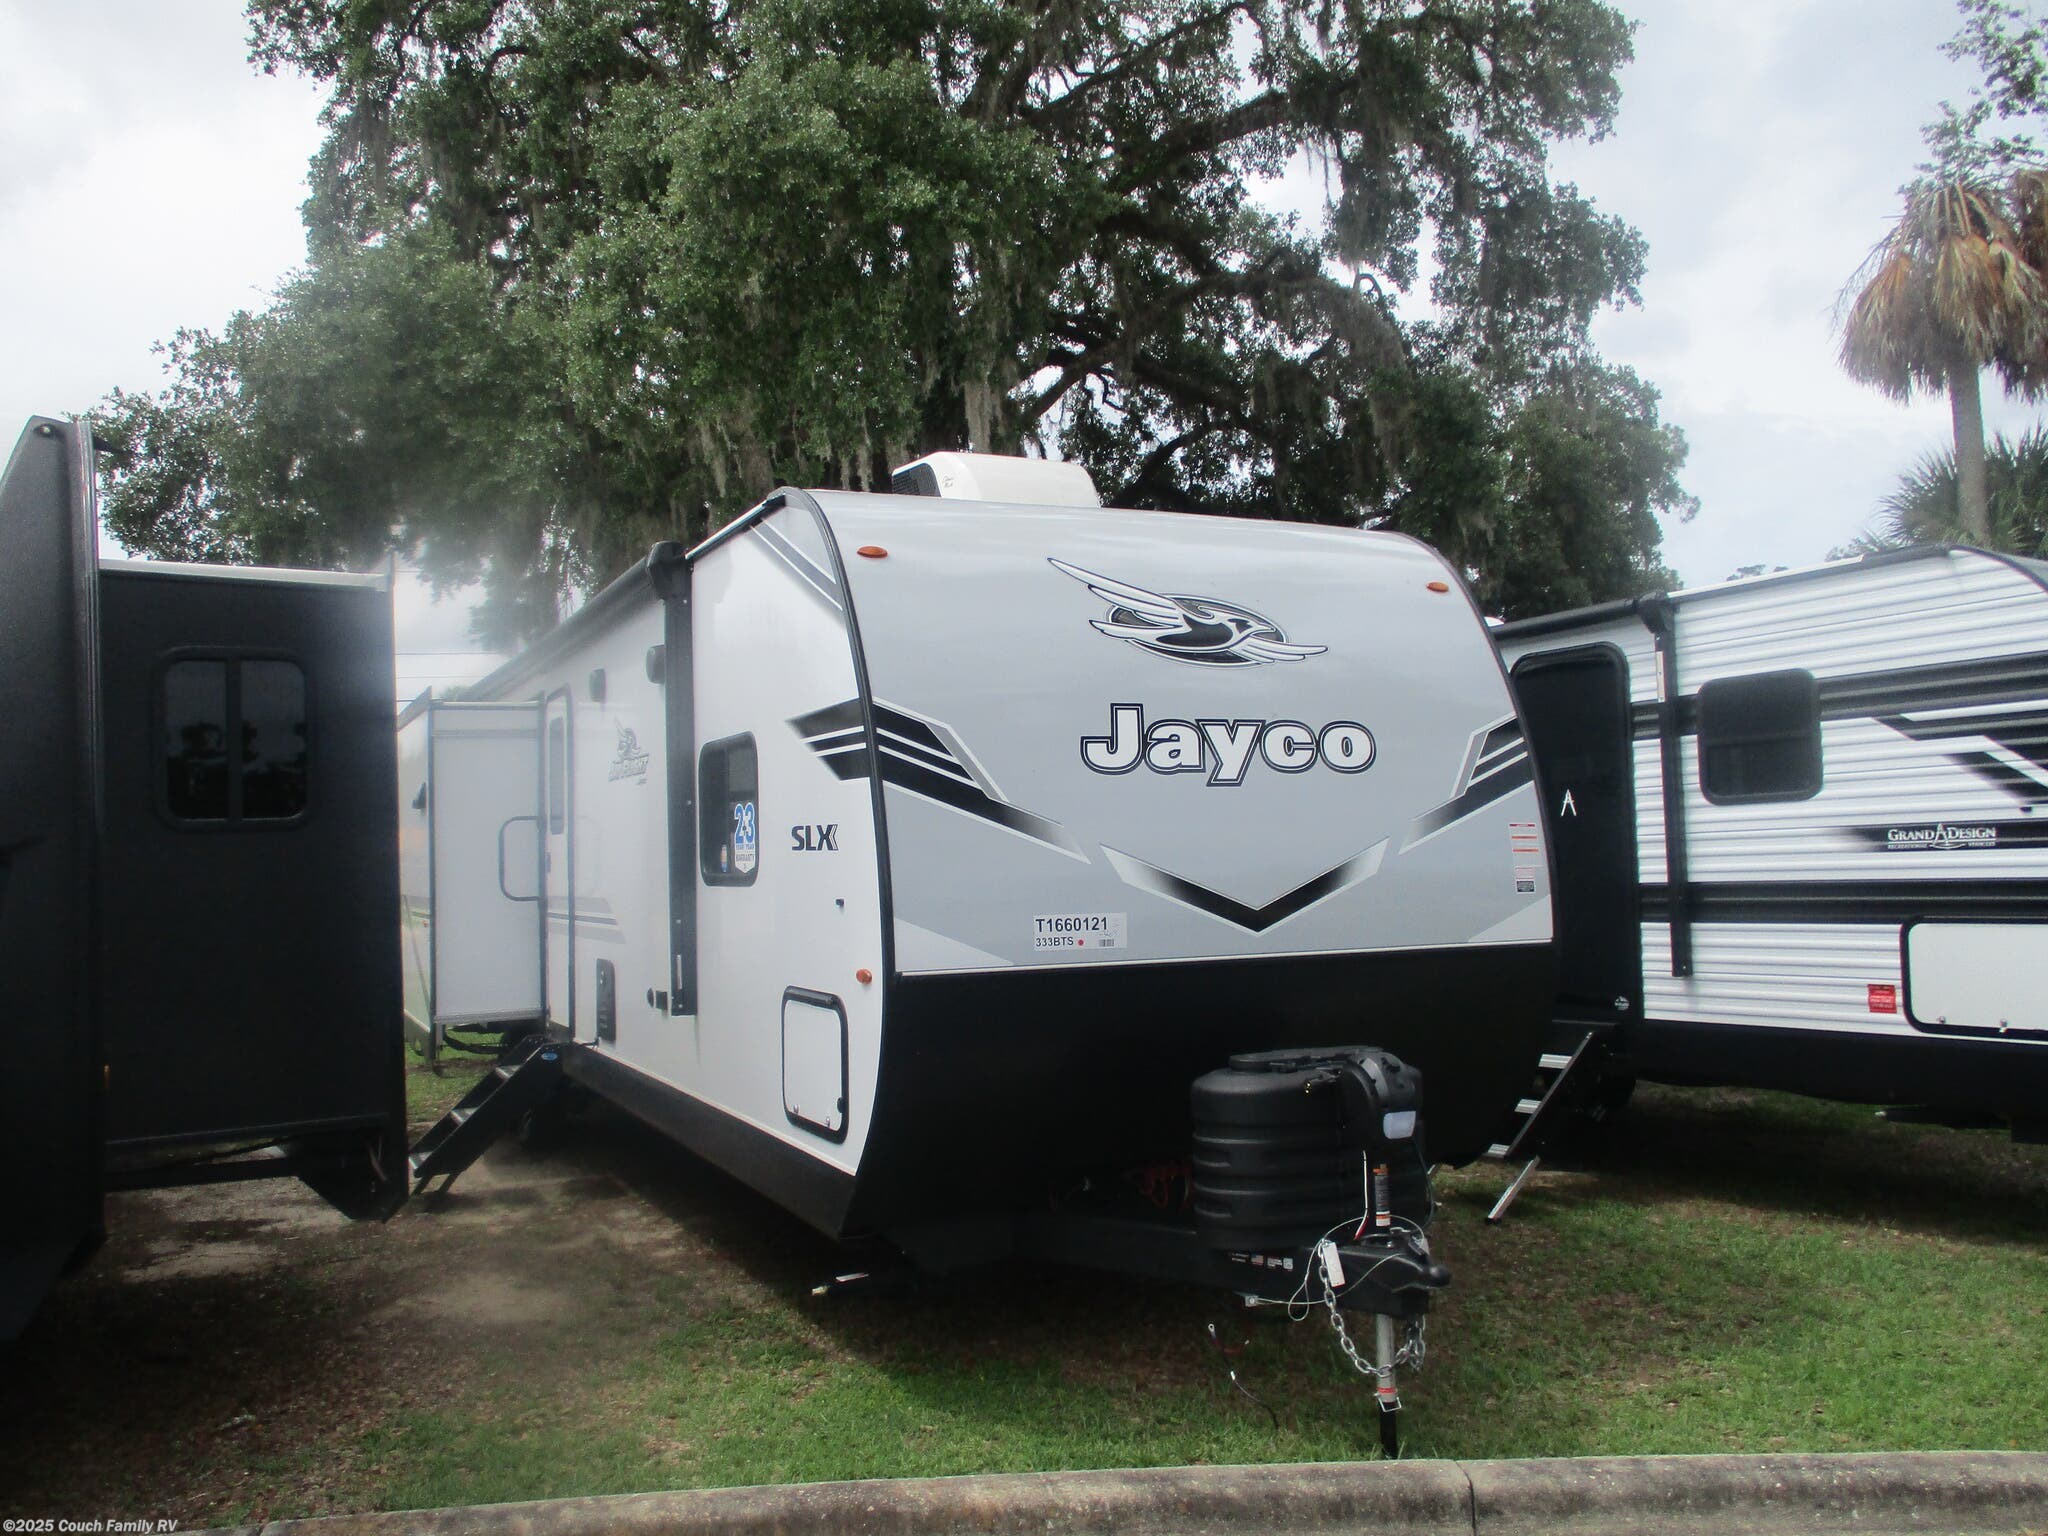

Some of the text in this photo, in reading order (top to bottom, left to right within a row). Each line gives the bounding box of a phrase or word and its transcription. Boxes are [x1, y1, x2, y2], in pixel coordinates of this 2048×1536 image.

[1080, 702, 1377, 787] Jayco
[791, 824, 839, 851] SLX
[1887, 826, 1996, 841] GRAND DESIGN
[1035, 916, 1108, 932] T1660121
[1035, 936, 1074, 947] 333BTS
